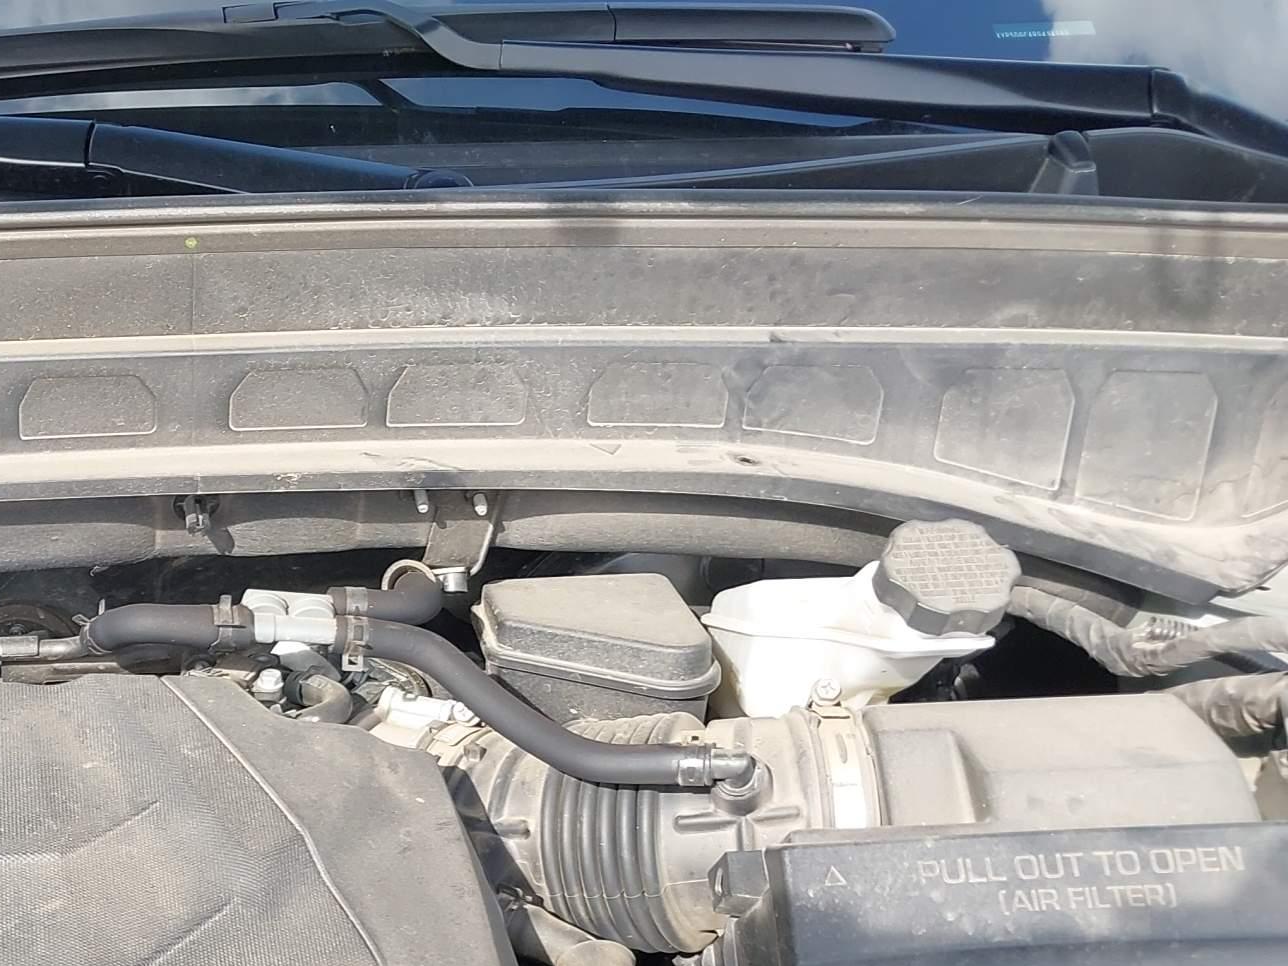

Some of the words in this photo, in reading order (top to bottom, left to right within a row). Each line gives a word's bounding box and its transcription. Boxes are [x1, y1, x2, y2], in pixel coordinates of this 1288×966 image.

[917, 856, 1008, 885] PULL
[1014, 852, 1083, 880] OUT
[1093, 850, 1141, 876] TO
[1149, 846, 1246, 874] OPEN
